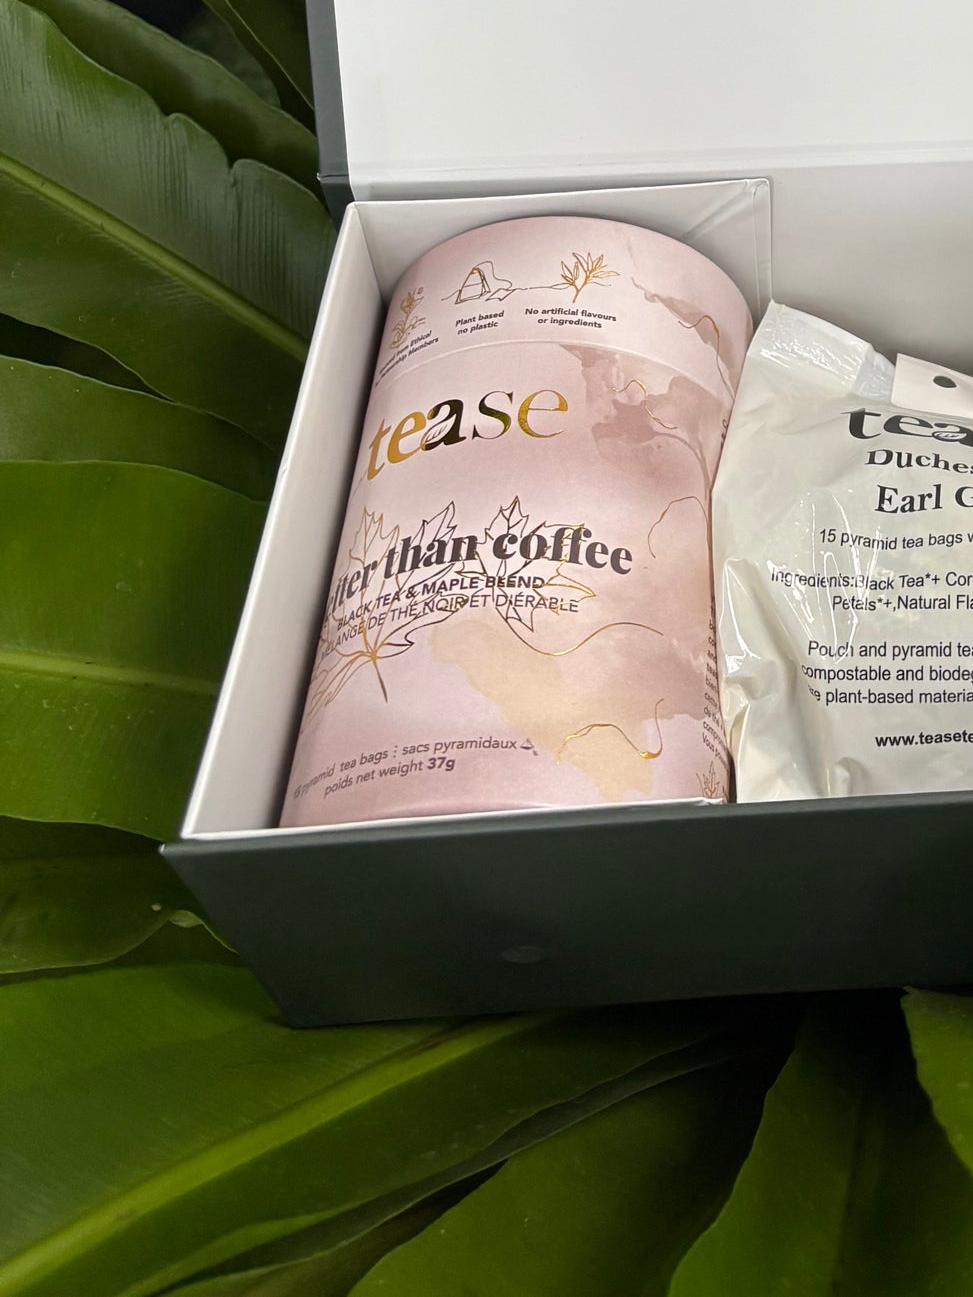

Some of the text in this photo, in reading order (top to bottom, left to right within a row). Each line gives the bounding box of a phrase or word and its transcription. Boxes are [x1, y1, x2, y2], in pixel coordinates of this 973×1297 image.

[455, 310, 504, 327] Plant based
[525, 308, 616, 322] No artificial flavours
[550, 317, 602, 329] ingredients
[457, 321, 498, 335] no plastic
[365, 389, 568, 480] tease
[875, 483, 944, 514] Earl
[820, 528, 836, 543] 15
[840, 532, 898, 550] pyramid
[902, 536, 924, 548] tea
[928, 532, 962, 547] bags
[384, 535, 478, 580] than
[492, 526, 632, 574] coffee
[336, 576, 545, 632] BLACK TEA & MAPLE BLEND
[368, 613, 386, 630] DE
[422, 596, 465, 614] NOIR
[470, 594, 490, 608] ET
[808, 640, 854, 658] Pouch
[859, 642, 886, 657] and
[892, 642, 952, 661] pyramid
[801, 664, 890, 684] compostable
[896, 666, 924, 681] and
[826, 688, 914, 706] plant-based
[340, 759, 356, 772] tea
[360, 750, 388, 765] bags
[402, 744, 430, 756] sacs
[434, 736, 517, 753] pyramidaux
[324, 756, 456, 799] poids net weight 37g
